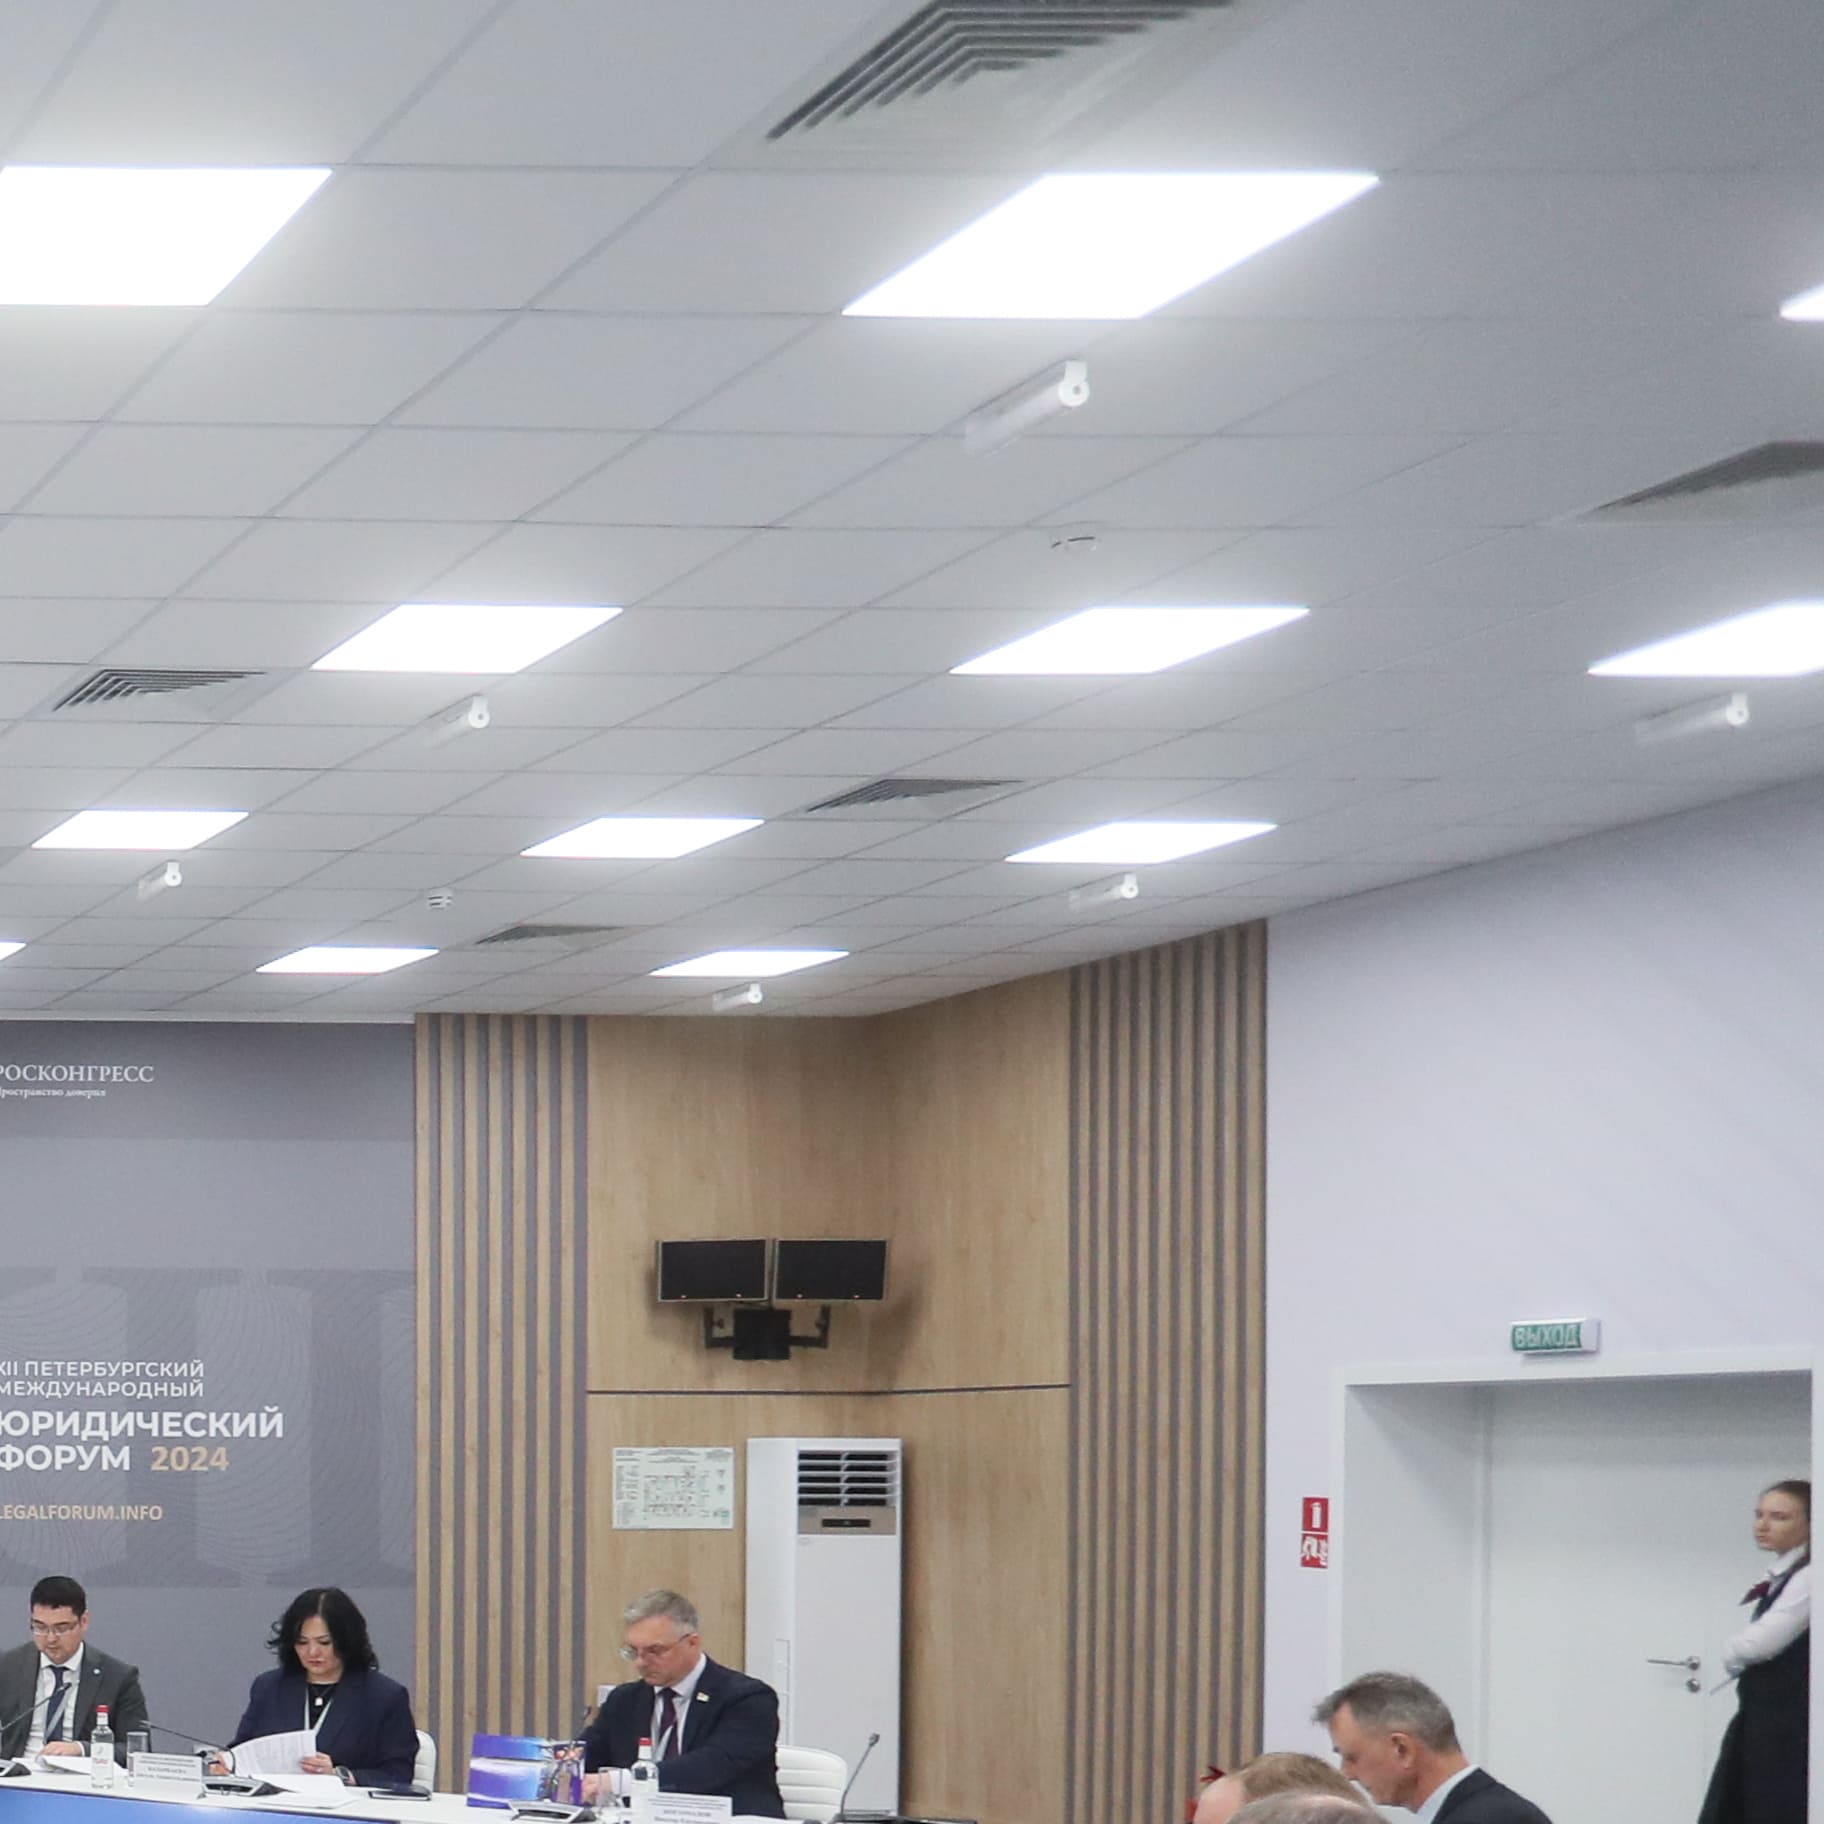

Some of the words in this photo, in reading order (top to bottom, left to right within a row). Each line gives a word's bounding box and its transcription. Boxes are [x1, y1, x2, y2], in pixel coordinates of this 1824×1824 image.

[65, 1089, 106, 1099] доверия
[1515, 1325, 1579, 1348] ВЫХОД
[25, 1359, 204, 1377] ПЕТЕРБУРГСКИЙ
[151, 1447, 229, 1471] 2024
